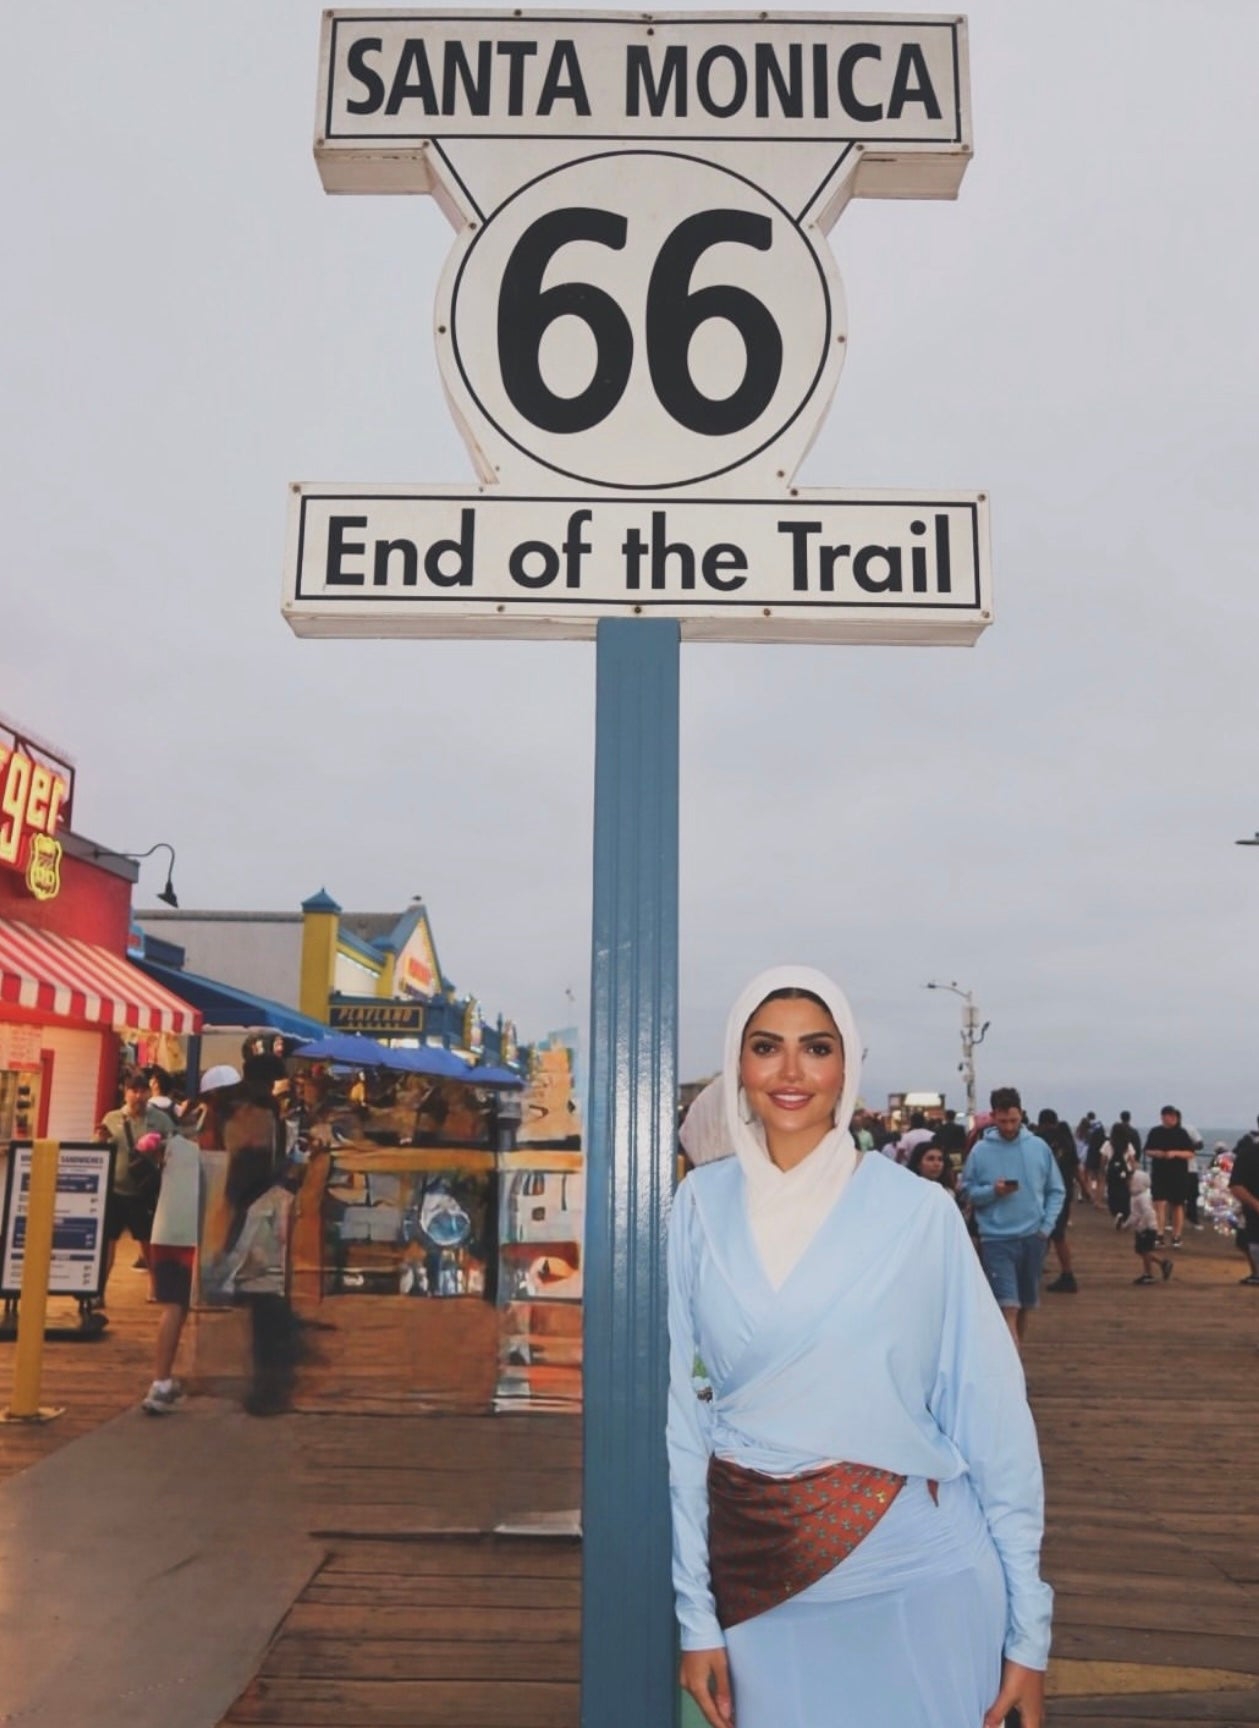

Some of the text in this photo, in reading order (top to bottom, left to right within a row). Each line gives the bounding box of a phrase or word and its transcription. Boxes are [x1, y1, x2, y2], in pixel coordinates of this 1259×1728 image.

[346, 37, 943, 123] SANTA MONICA
[497, 205, 783, 437] 66
[325, 508, 952, 594] End of the Trail
